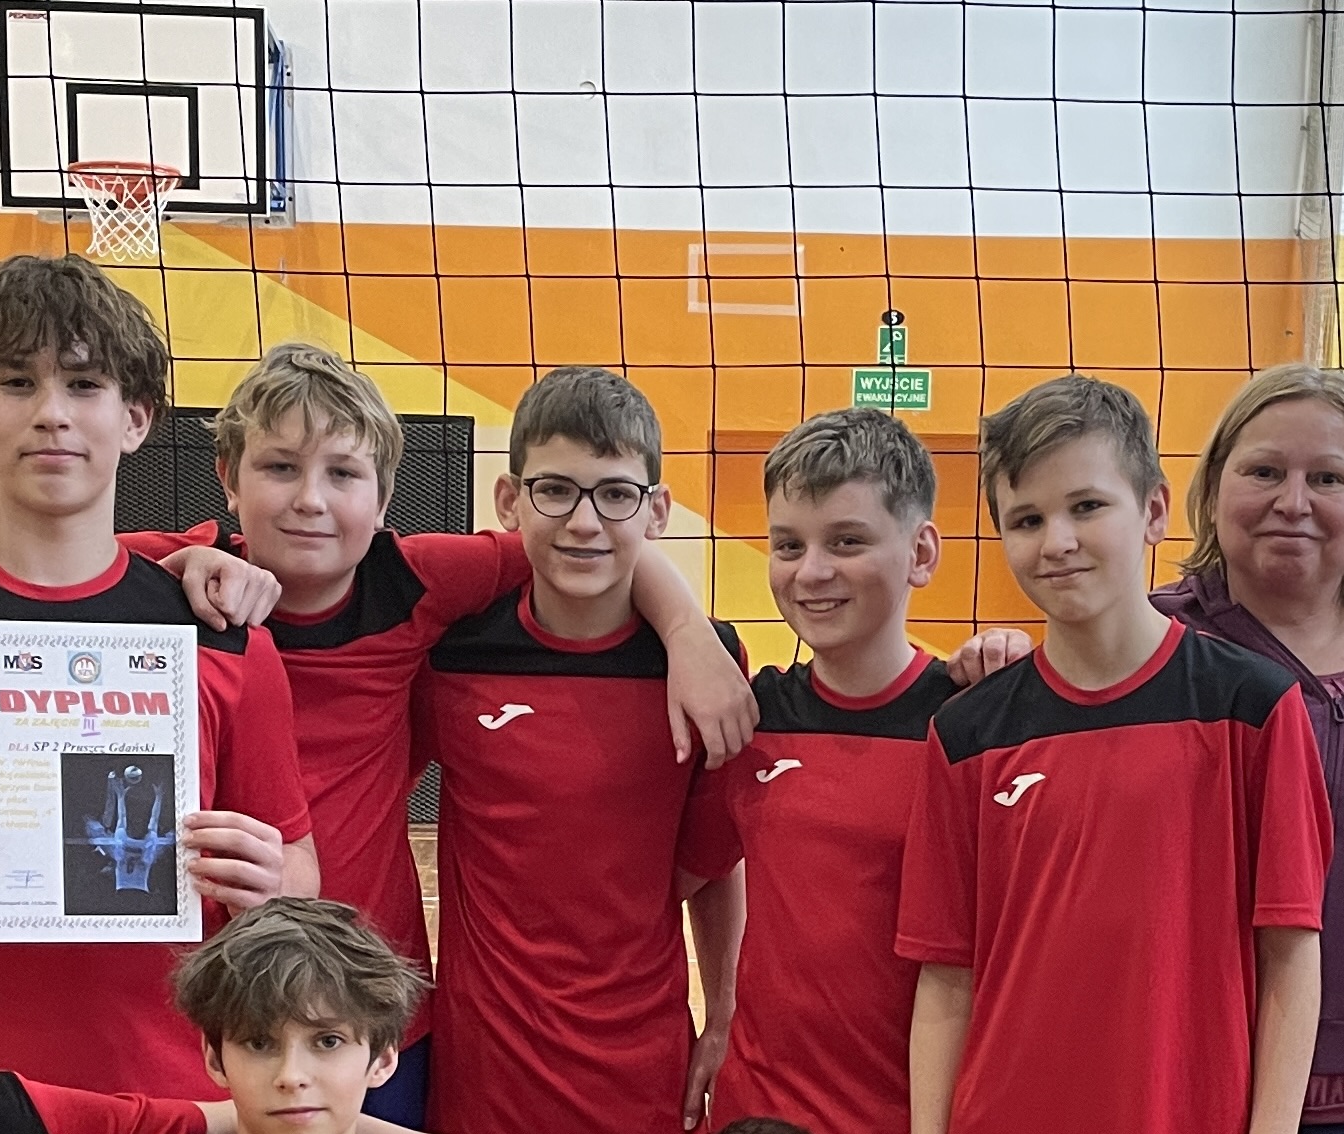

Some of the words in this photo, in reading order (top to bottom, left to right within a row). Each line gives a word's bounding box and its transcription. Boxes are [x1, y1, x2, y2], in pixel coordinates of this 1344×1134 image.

[32, 742, 50, 751] SP
[52, 742, 59, 751] 2
[63, 742, 105, 753] Pruszcz
[109, 742, 156, 752] Gdański
